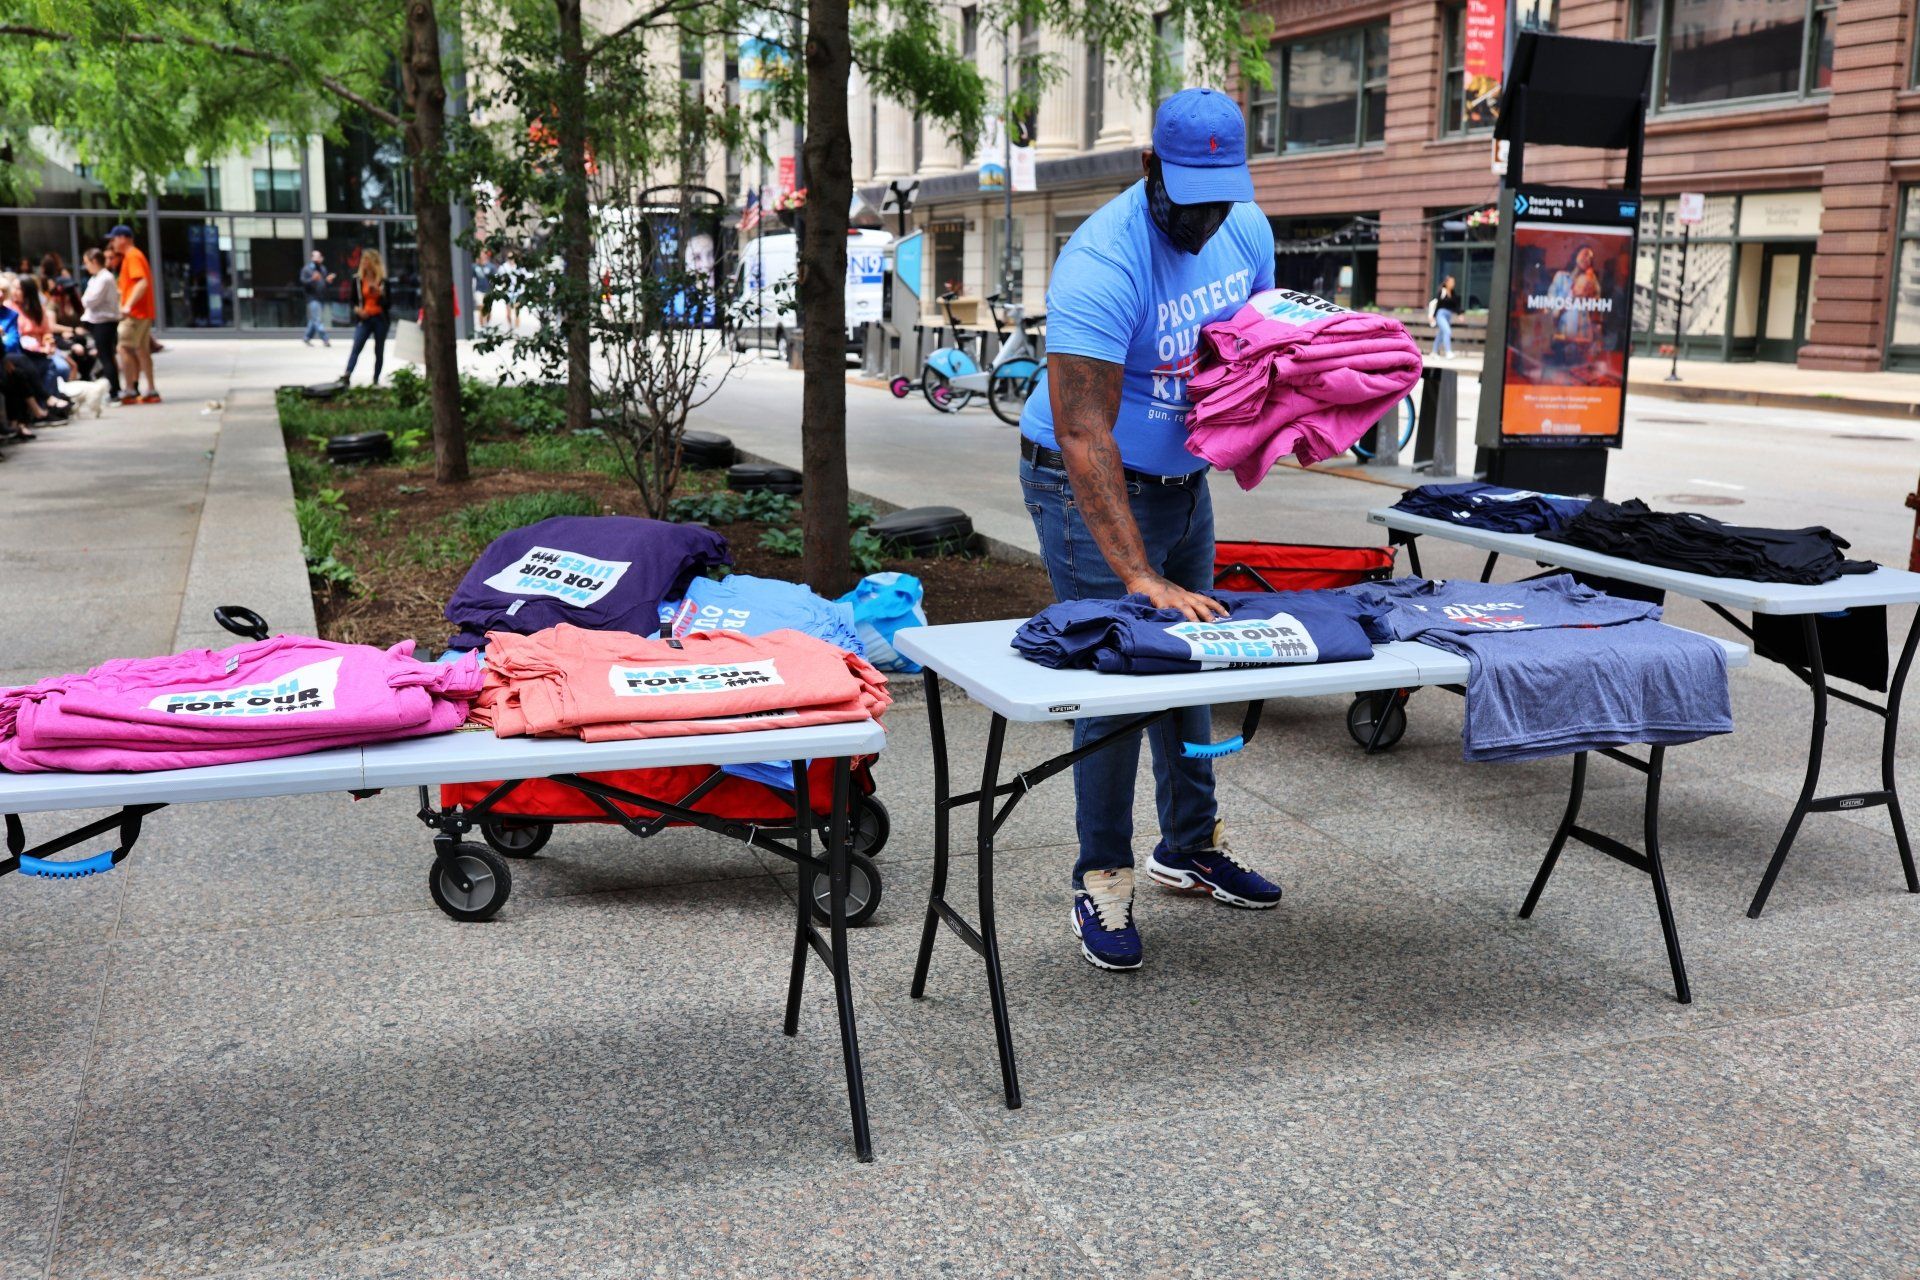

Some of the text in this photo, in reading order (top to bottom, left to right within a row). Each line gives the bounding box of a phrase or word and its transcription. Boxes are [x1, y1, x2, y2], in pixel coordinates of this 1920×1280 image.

[1158, 269, 1249, 331] PROTECT
[1151, 375, 1190, 401] KI
[1148, 408, 1171, 421] gun.
[519, 563, 604, 591] FOR OUR
[557, 556, 616, 580] LIVES
[516, 575, 593, 601] MARCH
[1184, 627, 1298, 642] FOR OUR
[1199, 641, 1274, 657] LIVES
[169, 678, 299, 703] MARCH
[626, 670, 762, 687] FOR OUR
[632, 680, 726, 694] LIVES
[166, 688, 321, 713] FOR OUR
